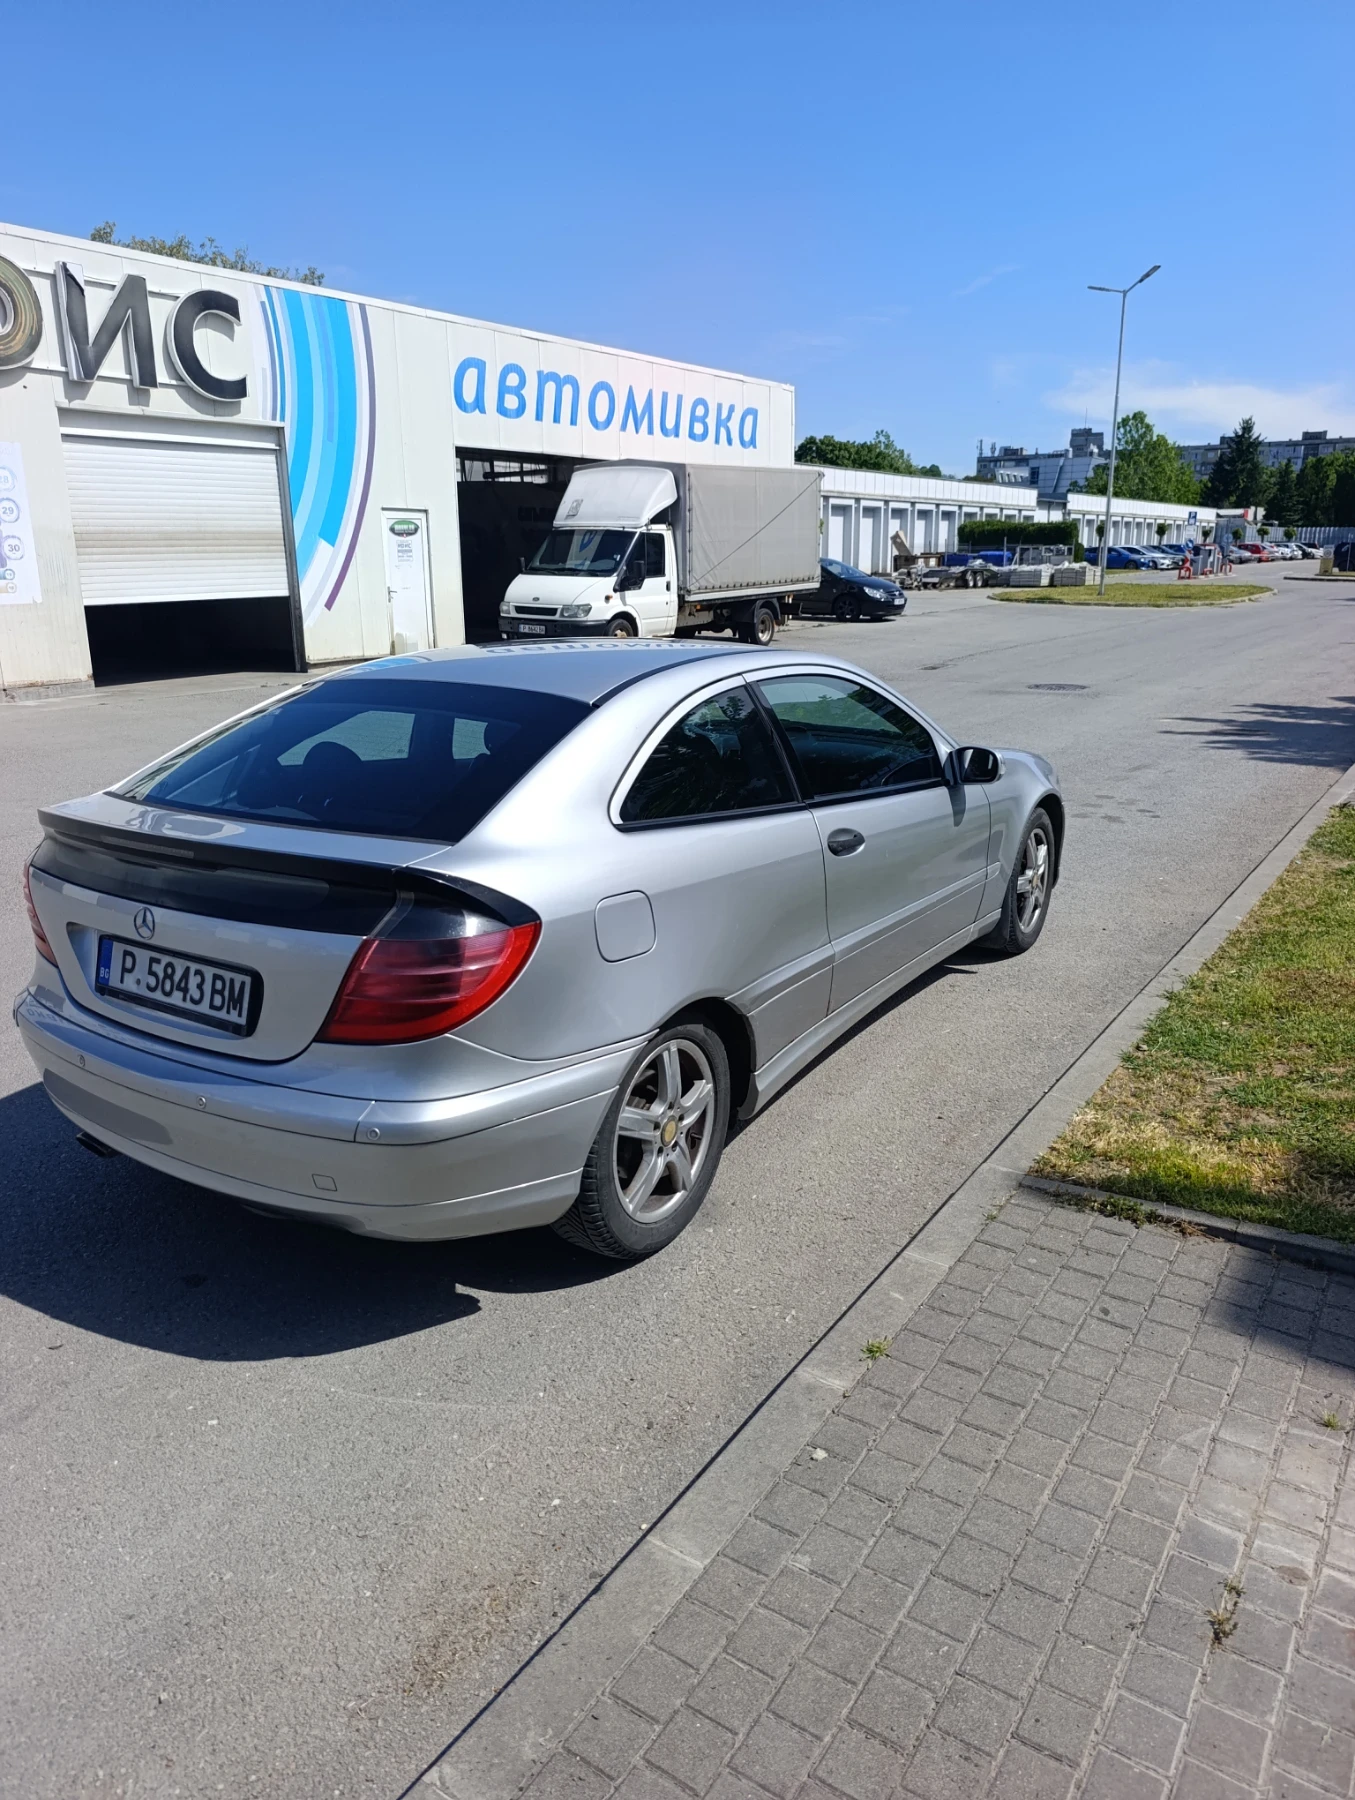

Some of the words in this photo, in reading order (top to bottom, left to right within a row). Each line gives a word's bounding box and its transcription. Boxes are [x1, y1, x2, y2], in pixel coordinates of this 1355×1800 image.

[453, 356, 759, 450] автомивка
[1, 506, 14, 515] 29
[8, 543, 20, 552] 30
[100, 967, 110, 978] BG
